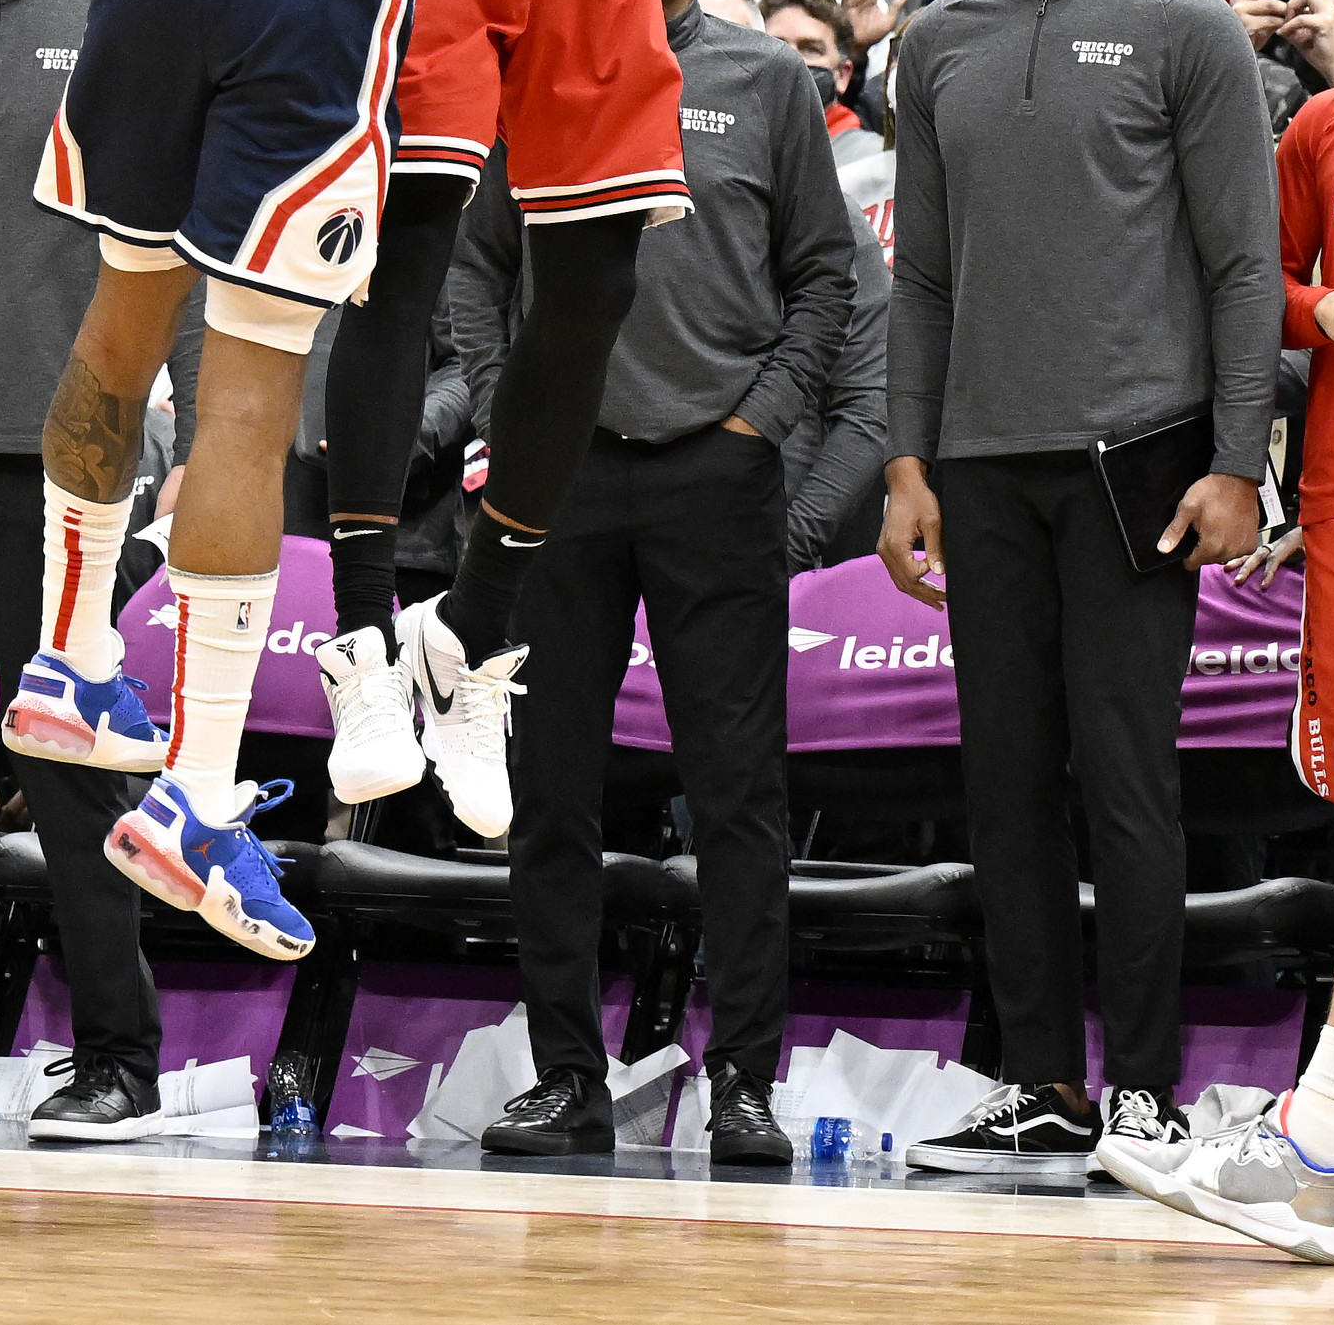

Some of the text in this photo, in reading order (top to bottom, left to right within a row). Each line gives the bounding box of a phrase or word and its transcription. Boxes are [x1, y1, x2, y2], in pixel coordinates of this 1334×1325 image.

[1072, 40, 1134, 56] CHICAGO
[1077, 52, 1123, 67] BULLS
[679, 107, 736, 126] HICAGO
[681, 119, 726, 135] BULLS
[1307, 718, 1331, 798] BULLS
